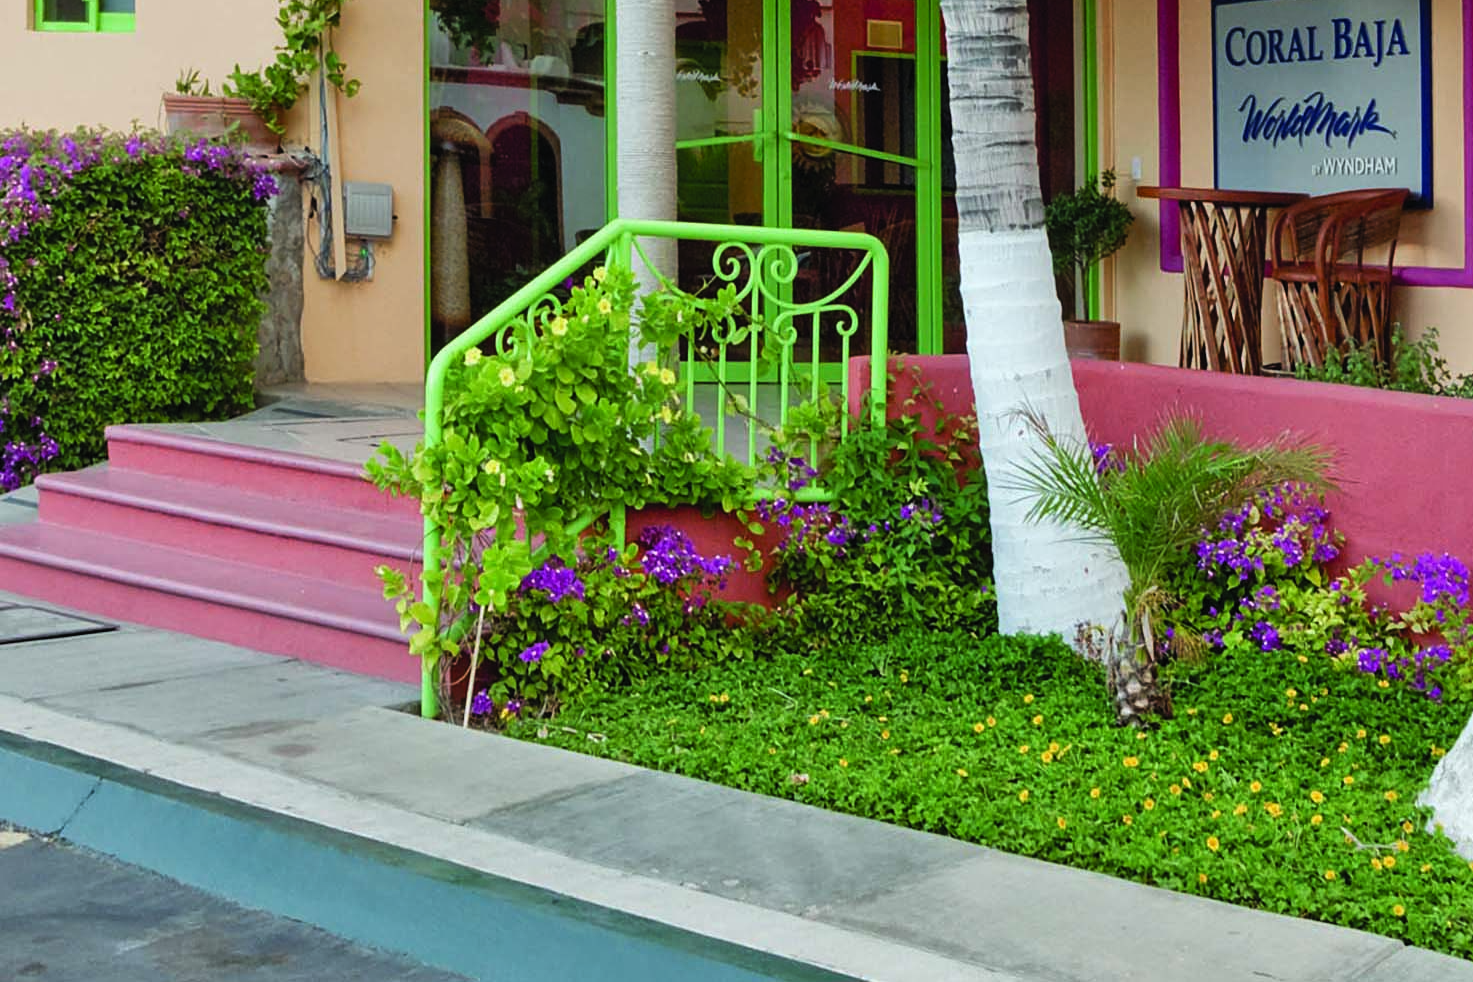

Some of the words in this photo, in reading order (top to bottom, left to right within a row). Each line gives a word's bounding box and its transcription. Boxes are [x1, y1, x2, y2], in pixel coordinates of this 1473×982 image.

[1225, 26, 1324, 67] CORAL
[1331, 18, 1411, 68] BAJA
[1238, 91, 1398, 149] WorldMark
[1323, 157, 1398, 175] WYNDHAM
